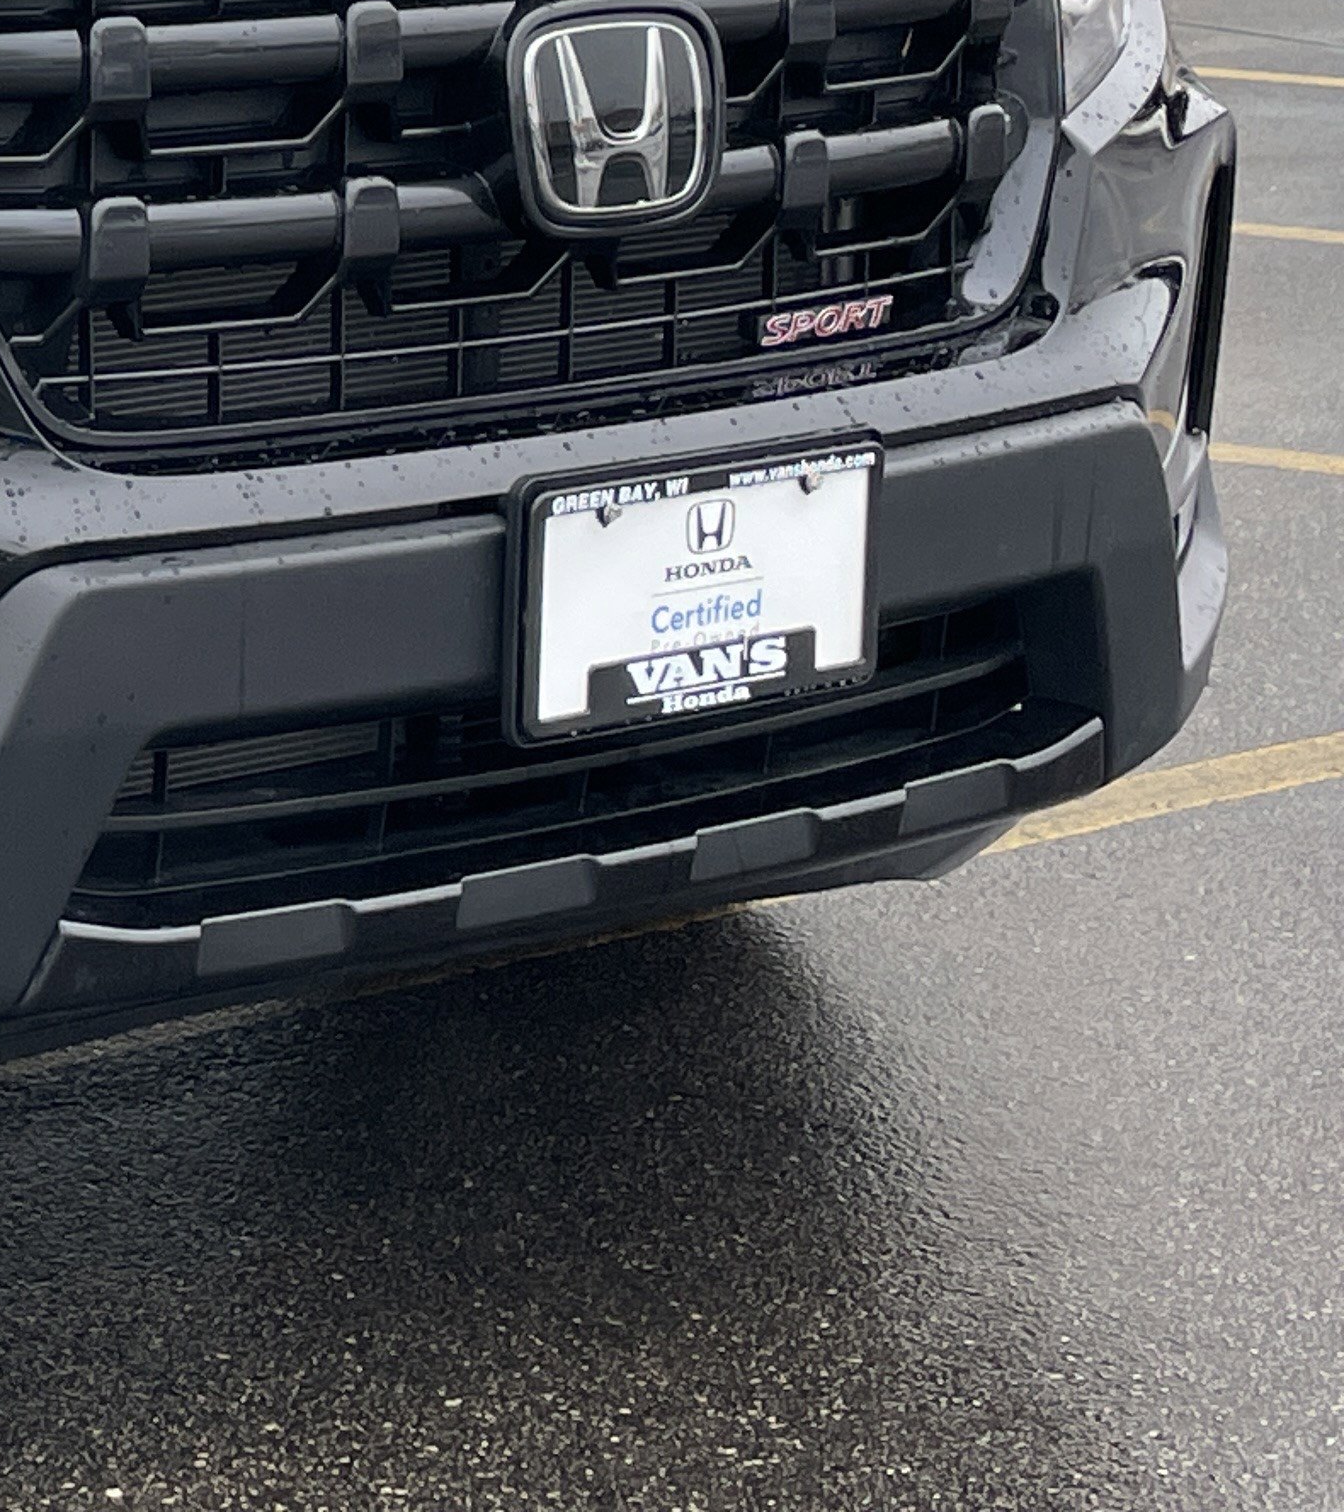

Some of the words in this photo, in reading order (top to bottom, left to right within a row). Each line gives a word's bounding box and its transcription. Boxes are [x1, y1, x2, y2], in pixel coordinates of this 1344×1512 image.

[761, 294, 894, 346] SPORT
[552, 488, 615, 516] GREEN
[618, 481, 661, 505] BAY,
[666, 477, 690, 497] WI
[665, 555, 752, 582] HONDA
[651, 588, 763, 634] Certified
[662, 684, 752, 714] Honda
